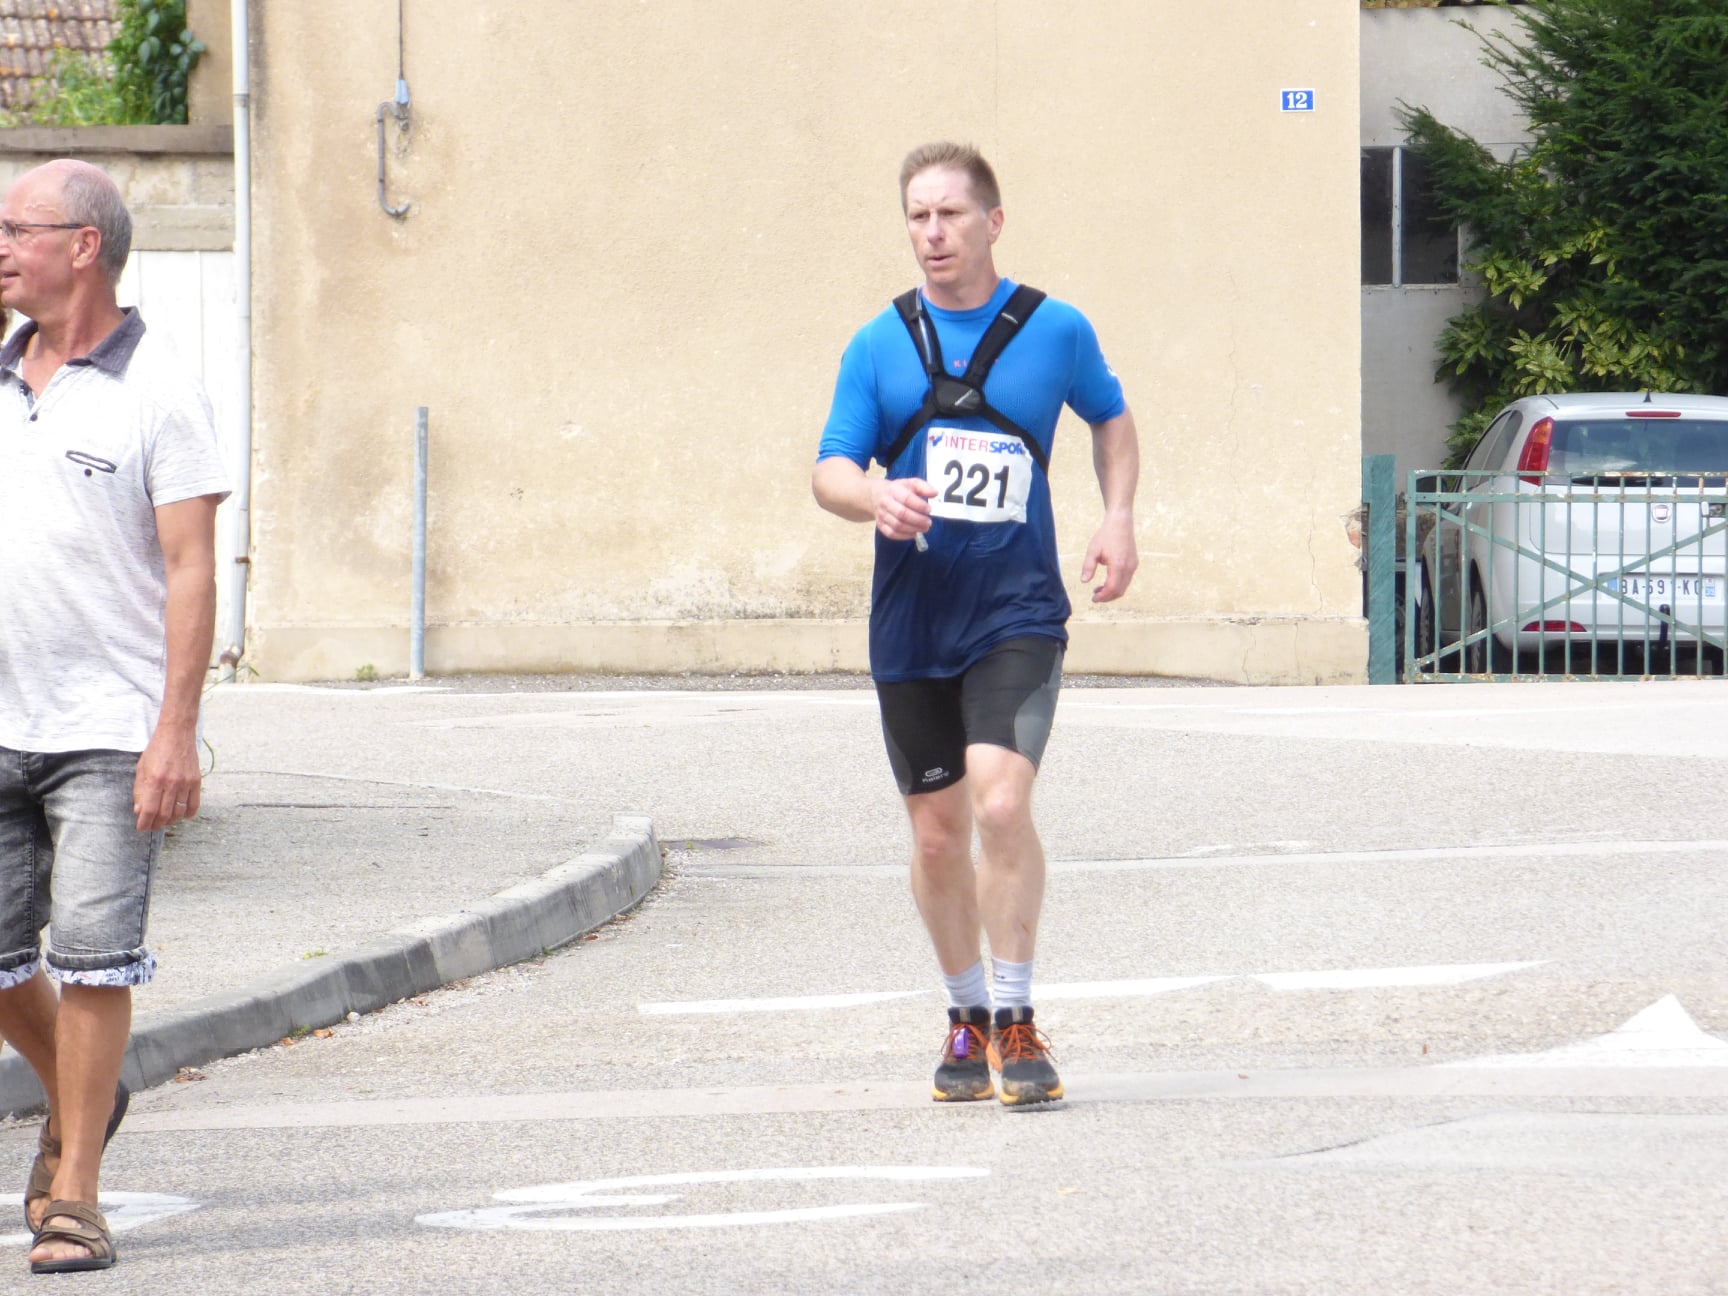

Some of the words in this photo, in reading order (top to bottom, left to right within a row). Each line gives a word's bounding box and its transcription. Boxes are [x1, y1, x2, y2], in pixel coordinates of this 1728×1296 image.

[1287, 92, 1308, 109] 12
[945, 434, 1025, 455] INTERSPOR
[943, 459, 1010, 509] 221
